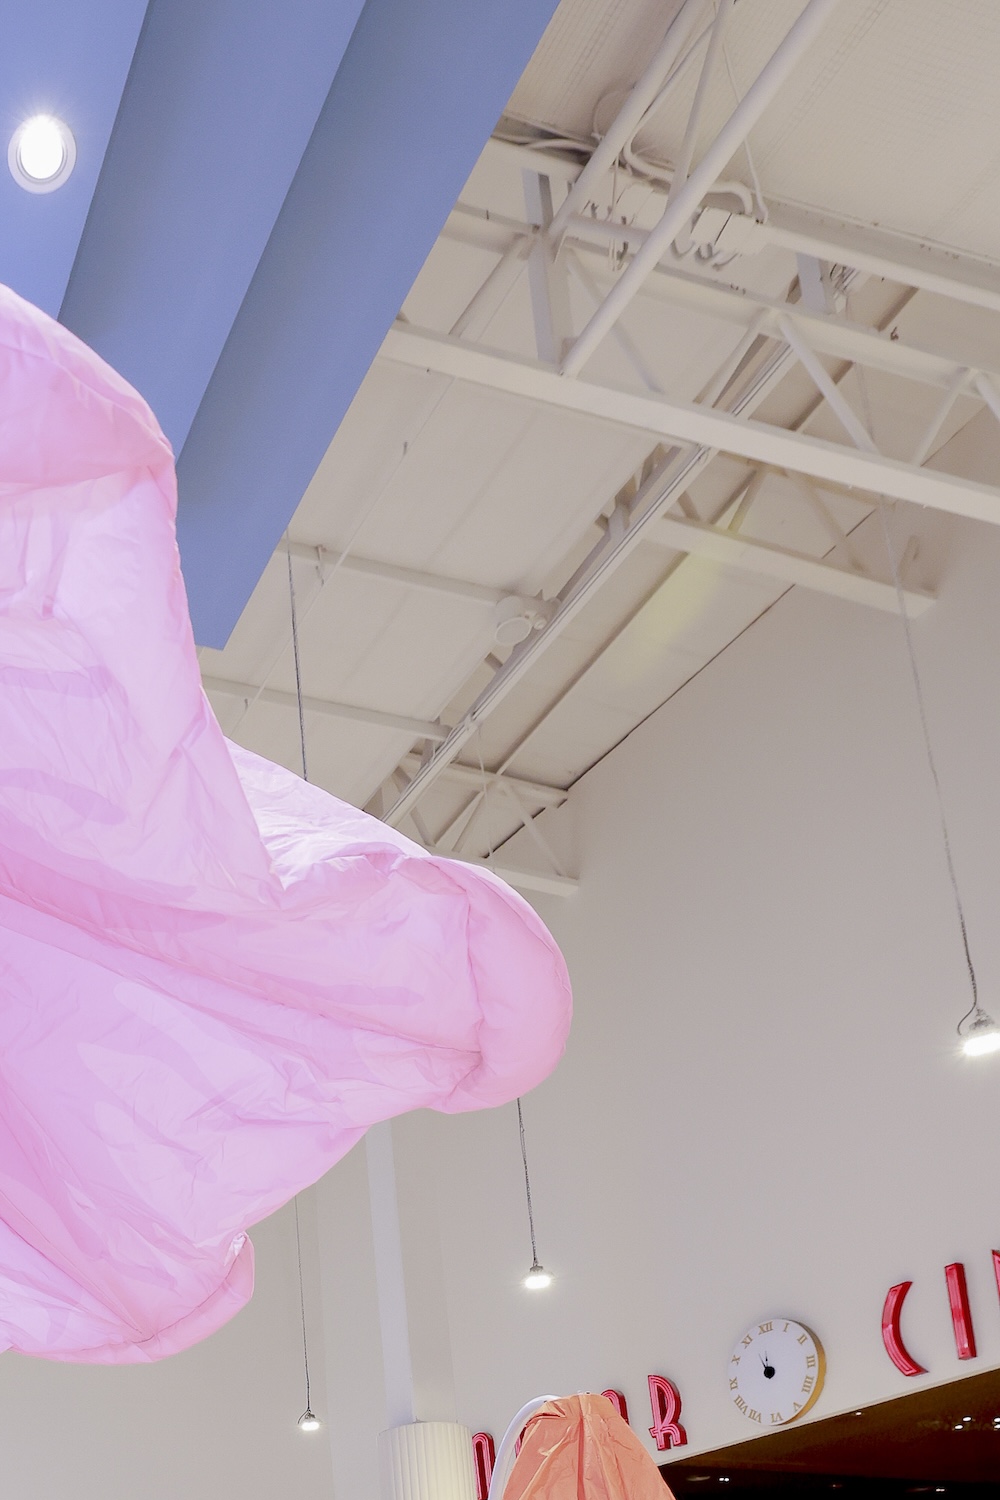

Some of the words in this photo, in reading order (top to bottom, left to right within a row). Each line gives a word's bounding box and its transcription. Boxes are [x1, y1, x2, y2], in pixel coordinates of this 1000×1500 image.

[758, 1321, 774, 1335] XII
[782, 1323, 790, 1333] I
[741, 1334, 754, 1349] XI
[797, 1334, 808, 1345] II
[731, 1355, 741, 1366] X
[806, 1355, 816, 1368] III
[729, 1377, 738, 1390] IX
[793, 1402, 803, 1412] V
[748, 1409, 762, 1423] VII
[770, 1412, 784, 1423] VI
